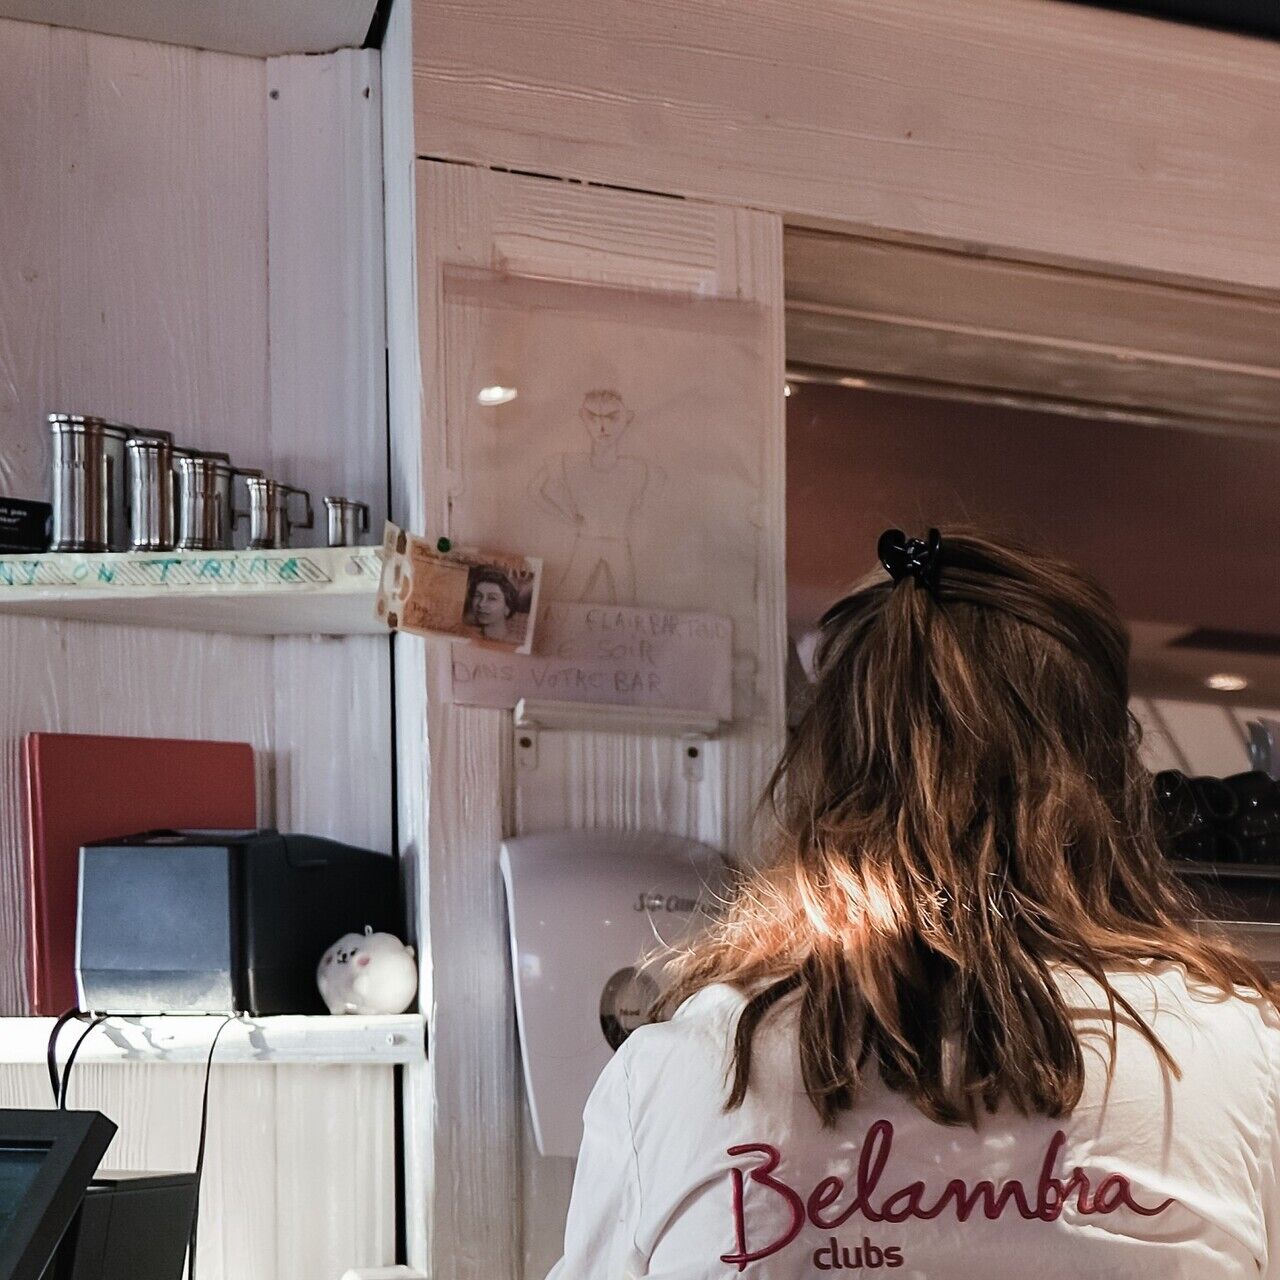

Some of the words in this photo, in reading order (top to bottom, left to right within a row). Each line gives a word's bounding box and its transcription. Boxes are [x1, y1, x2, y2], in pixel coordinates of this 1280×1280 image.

[614, 670, 662, 692] BAR
[719, 1118, 1174, 1272] Belambra
[812, 1236, 905, 1270] clubs
